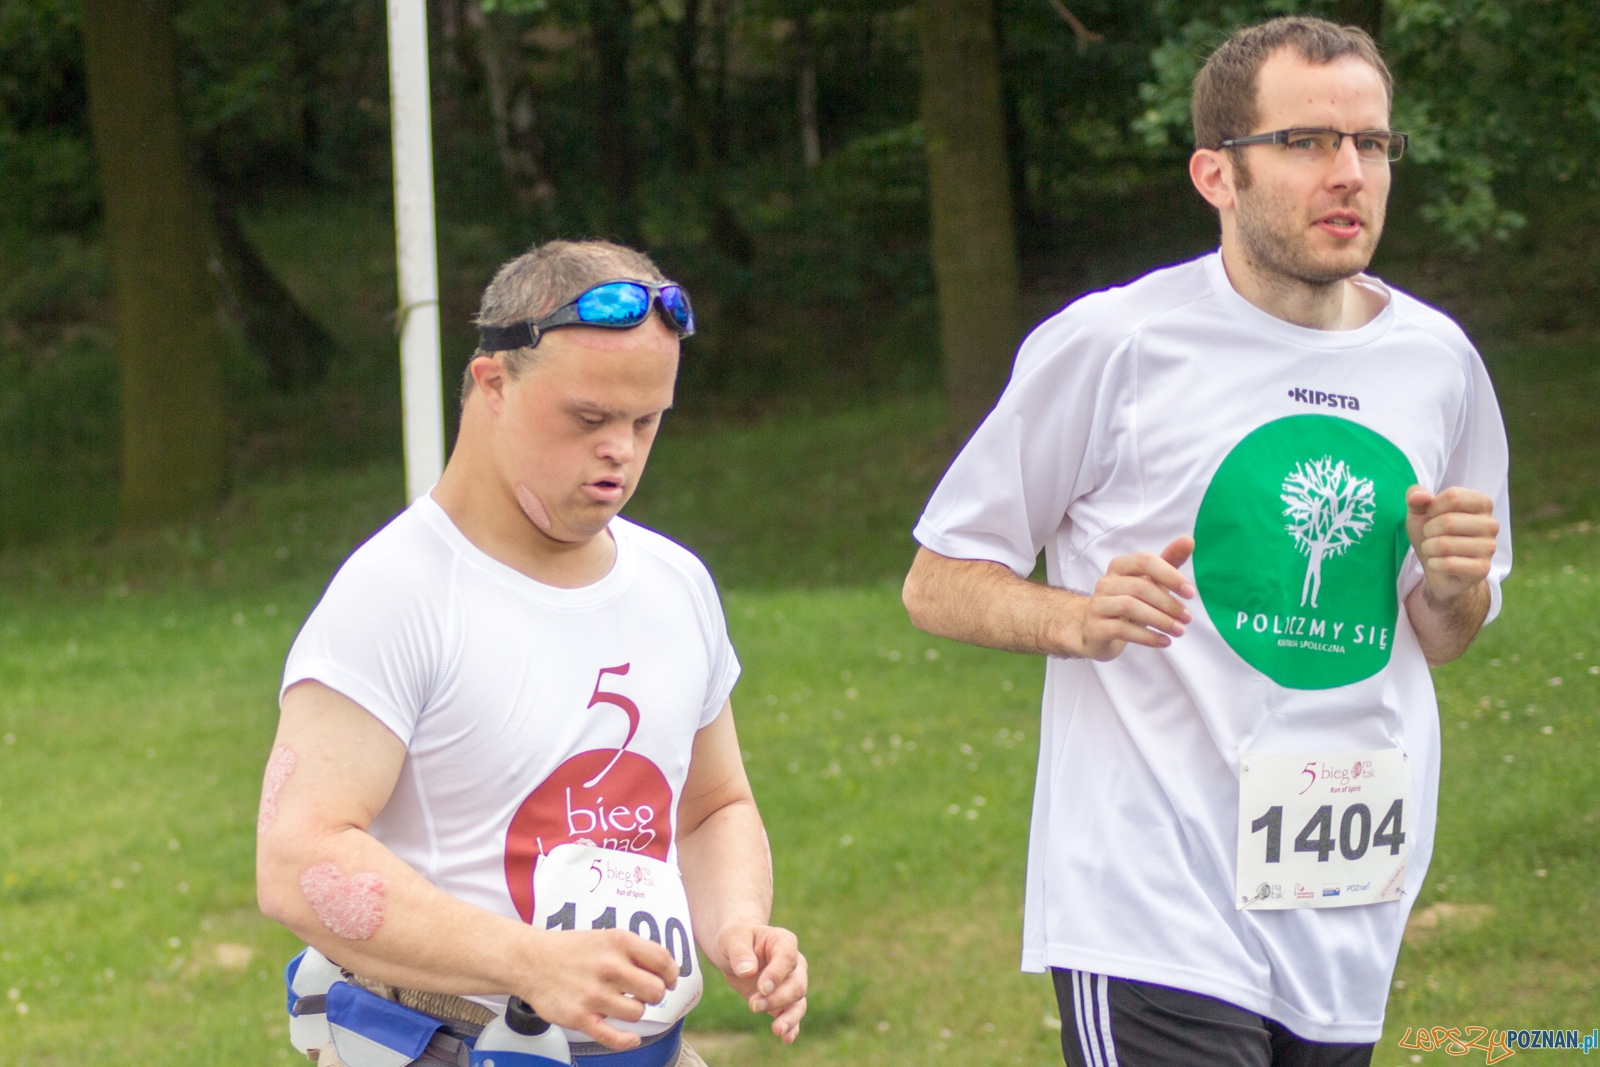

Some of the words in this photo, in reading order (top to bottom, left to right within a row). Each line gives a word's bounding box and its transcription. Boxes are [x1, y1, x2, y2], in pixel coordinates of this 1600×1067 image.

[1236, 611, 1344, 640] POLICZMY
[1353, 624, 1388, 650] SIĘ
[583, 662, 640, 789] 5
[1299, 762, 1317, 795] 5
[1321, 763, 1350, 785] bieg
[1348, 785, 1361, 794] Spirit
[566, 787, 656, 851] bieg
[1251, 799, 1405, 863] 1404
[589, 859, 602, 893] 5
[607, 861, 633, 889] bieg
